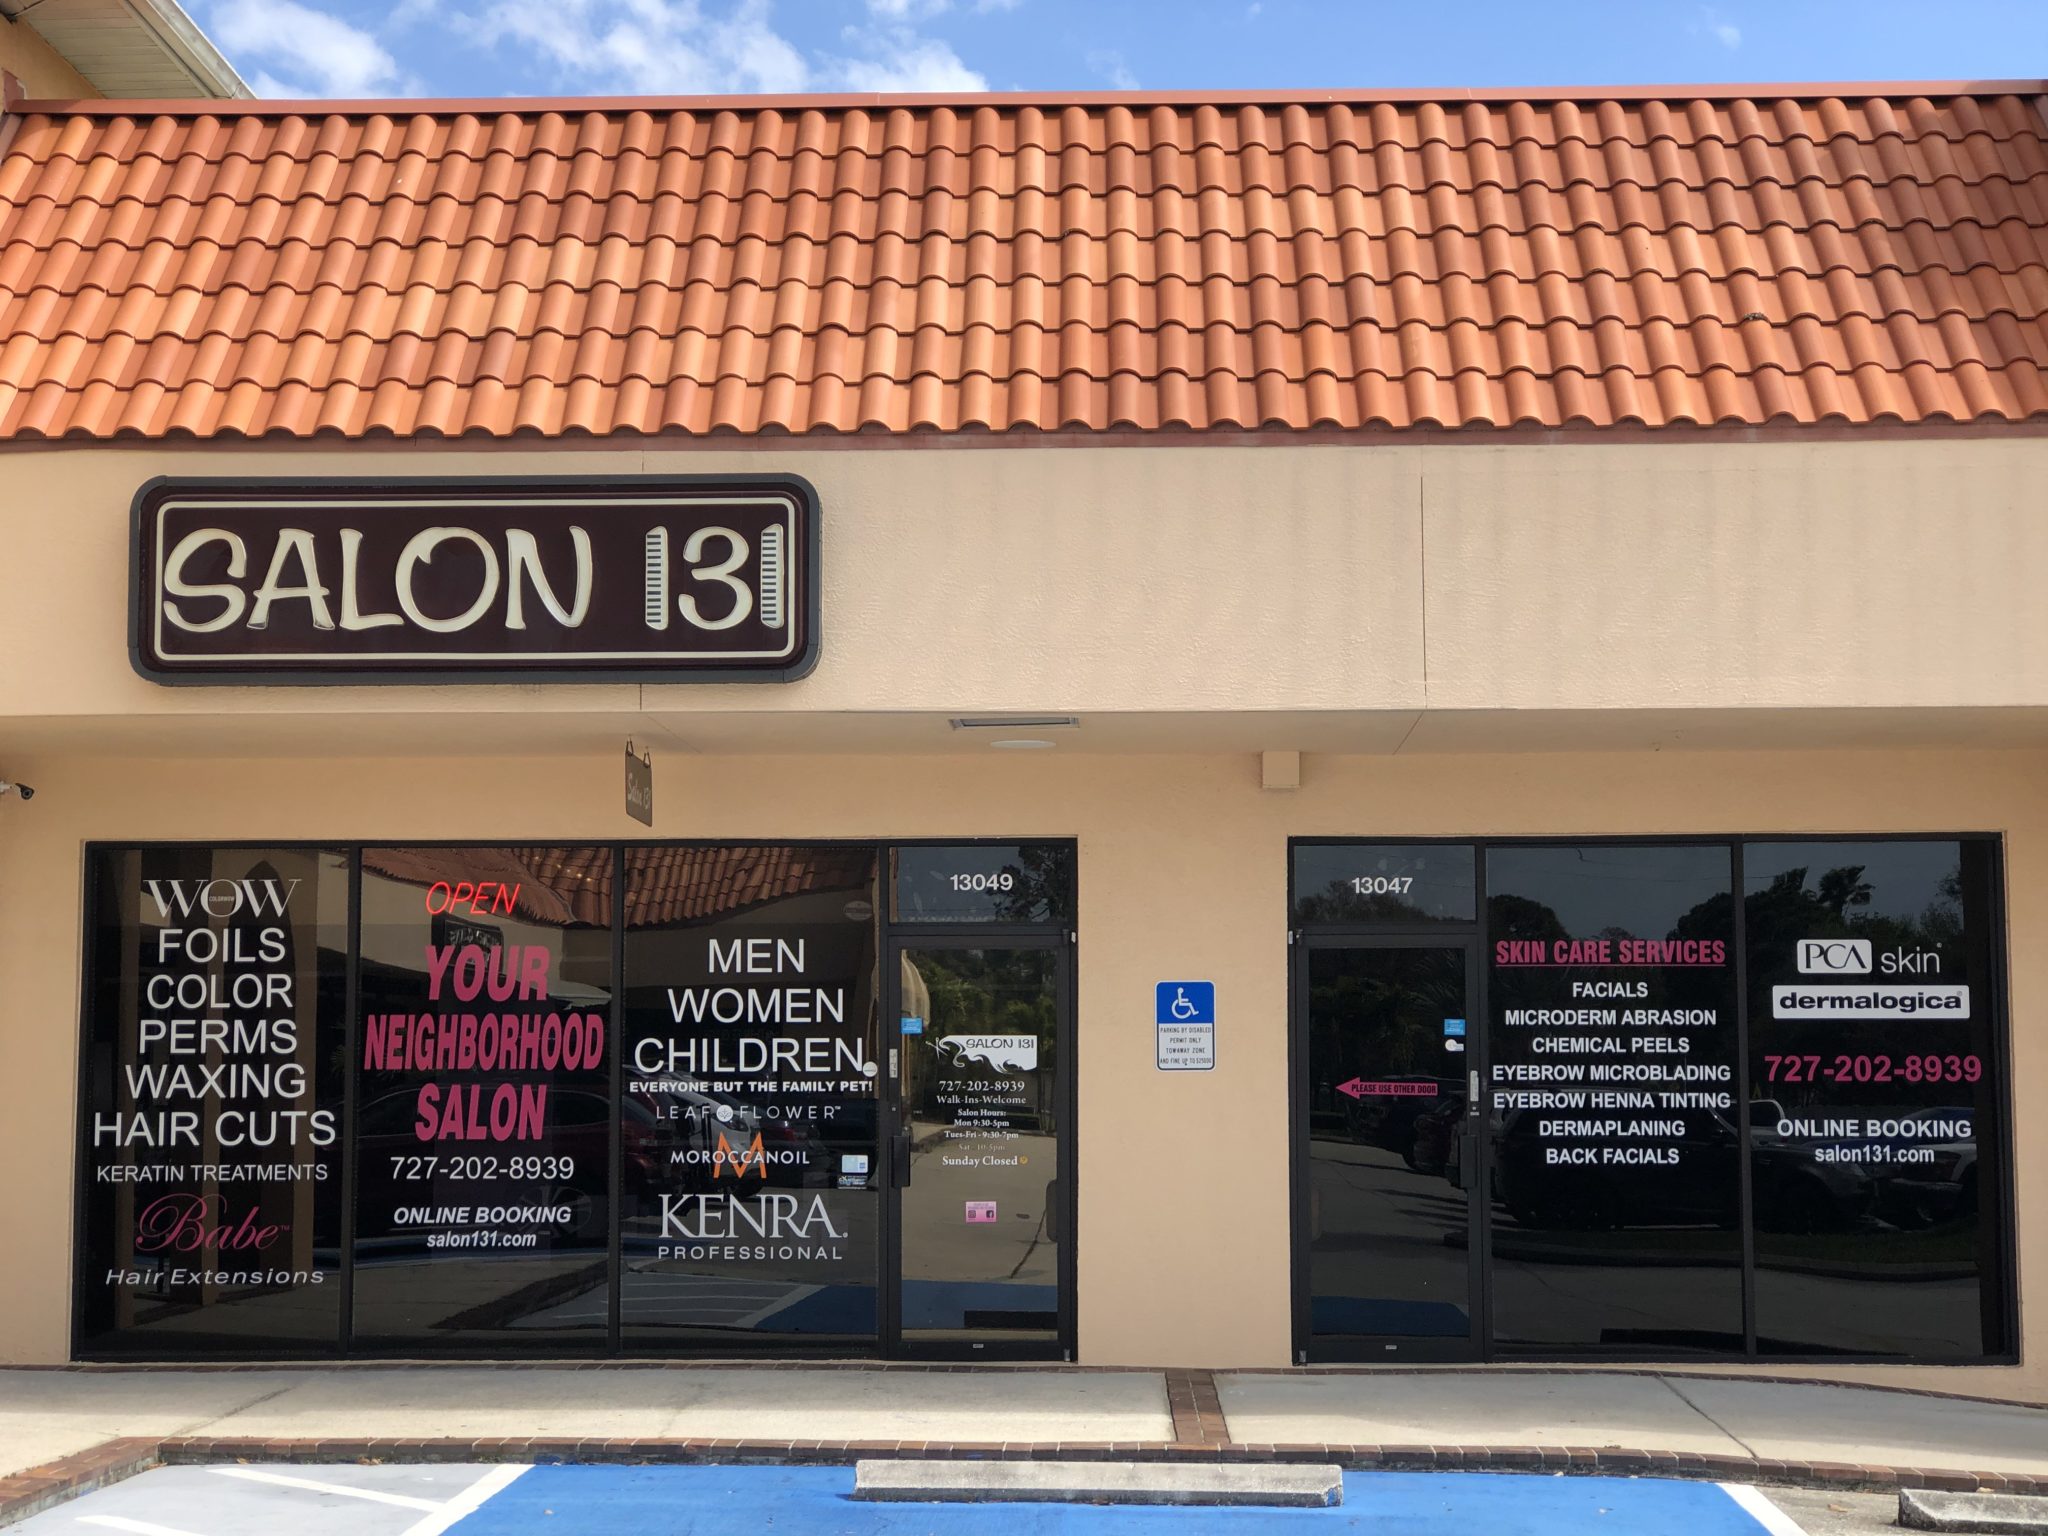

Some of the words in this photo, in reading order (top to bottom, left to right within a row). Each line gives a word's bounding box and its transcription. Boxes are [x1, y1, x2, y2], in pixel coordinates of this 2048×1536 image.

[162, 524, 594, 634] SALON
[644, 522, 786, 631] 131
[949, 873, 1014, 892] 13049
[1351, 876, 1414, 895] 13047
[143, 878, 303, 919] WOW
[424, 880, 521, 916] OPEN
[157, 927, 287, 964] FOILS
[1495, 940, 1546, 964] SKIN
[1553, 940, 1612, 964] CARE
[1618, 940, 1727, 964] SERVICES
[707, 937, 806, 974] MEN
[1804, 943, 1868, 970] PCA
[1880, 945, 1942, 974] skin
[424, 944, 551, 1002] YOUR
[146, 973, 294, 1010] COLOR
[1572, 981, 1649, 998] FACIALS
[667, 987, 845, 1024] WOMEN
[1779, 991, 1963, 1014] dermalogica
[1505, 1009, 1617, 1026] MICRODERM
[1621, 1009, 1717, 1026] ABRASION
[138, 1018, 299, 1055] PERMS
[363, 1012, 605, 1072] NEIGHBORHOOD
[965, 1038, 1014, 1049] SALON
[1017, 1038, 1035, 1049] 131
[1532, 1037, 1627, 1054] CHEMICAL
[1631, 1037, 1690, 1054] PEELS
[633, 1036, 864, 1074] CHILDREN
[1492, 1064, 1586, 1081] EYEBROW
[1590, 1064, 1732, 1081] MICROBLADING
[1764, 1054, 1983, 1083] 727-202-8939
[125, 1063, 307, 1100] WAXING
[629, 1081, 712, 1093] EVERYONE
[713, 1081, 744, 1093] BUT
[748, 1081, 778, 1093] THE
[782, 1081, 837, 1093] FAMILY
[839, 1080, 873, 1093] PET!
[938, 1080, 1026, 1093] 727-202-8939
[1351, 1084, 1377, 1093] PLEASE
[1378, 1084, 1392, 1093] USE
[1393, 1084, 1416, 1094] OTHER
[1417, 1085, 1437, 1094] DOOR
[936, 1095, 1027, 1105] Walk-Ins-Welcome
[1493, 1092, 1586, 1109] EYEBROW
[1591, 1092, 1656, 1109] HENNA
[1658, 1092, 1732, 1109] TINTING
[414, 1082, 548, 1142] SALON
[655, 1105, 712, 1120] LEAF
[957, 1108, 979, 1117] Salon
[980, 1108, 1007, 1117] Hours:
[93, 1111, 200, 1148] HAIR
[214, 1110, 337, 1147] CUTS
[953, 1119, 972, 1127] Mon
[972, 1119, 1010, 1129] 9:30-5pm
[1538, 1120, 1686, 1137] DERMAPLANING
[1776, 1118, 1861, 1138] ONLINE
[1866, 1118, 1972, 1138] BOOKING
[944, 1130, 977, 1139] Tues-Fri
[982, 1131, 1020, 1141] 9:30-7pm
[670, 1150, 811, 1165] MOROCCANOIL
[942, 1155, 980, 1168] Sunday
[982, 1155, 1018, 1166] Closed
[1546, 1148, 1598, 1164] BACK
[1603, 1148, 1680, 1164] FACIALS
[1814, 1144, 1936, 1163] salon131.com
[96, 1165, 185, 1183] KERATIN
[190, 1163, 329, 1182] TREATMENTS
[390, 1155, 575, 1181] 727-202-8939
[393, 1206, 471, 1225] ONLINE
[474, 1206, 572, 1225] BOOKING
[658, 1193, 843, 1239] KENRA
[426, 1230, 538, 1249] salon131.com
[658, 1246, 843, 1261] PROFESSIONAL
[105, 1269, 164, 1286] Hair
[170, 1267, 325, 1286] Extensions
